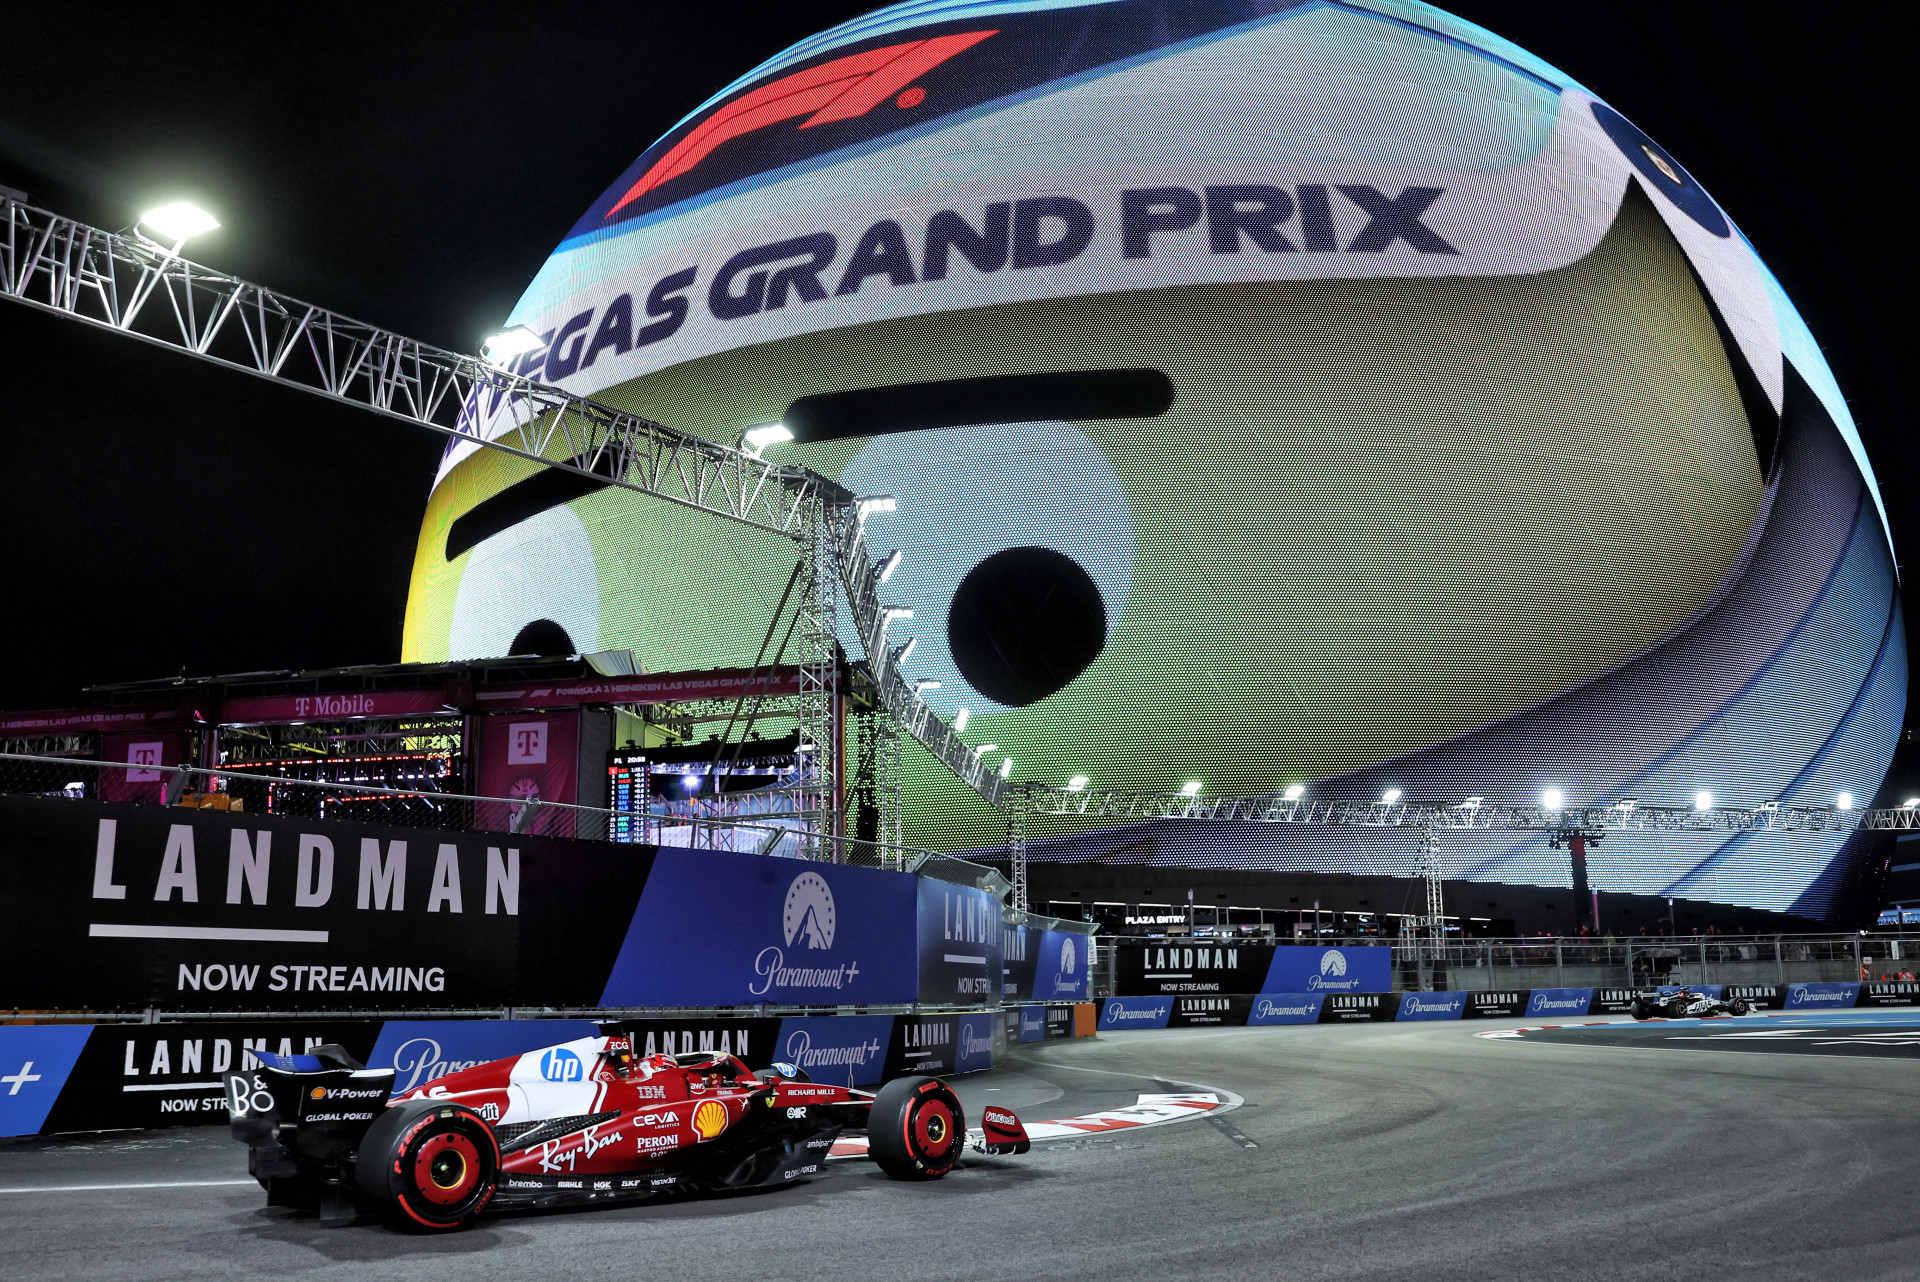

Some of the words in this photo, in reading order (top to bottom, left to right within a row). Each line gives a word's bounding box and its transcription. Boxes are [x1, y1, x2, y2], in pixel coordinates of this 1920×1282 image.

[706, 196, 1096, 321] GRAND
[1120, 184, 1461, 261] PRIX
[556, 687, 603, 696] FORMULA
[612, 683, 661, 693] HEINEKEN
[663, 680, 683, 690] LAS
[684, 678, 720, 689] VEGAS
[314, 694, 374, 716] Mobile
[50, 718, 67, 726] LAS
[93, 712, 125, 722] GRAND
[125, 712, 146, 721] PRIX
[92, 818, 521, 916] LANDMAN
[1125, 916, 1155, 924] PLAZA
[1157, 915, 1186, 924] ENTRY
[1144, 948, 1238, 969] LANDMAN
[177, 963, 260, 992] NOW
[268, 964, 445, 993] STREAMING
[748, 946, 860, 995] Paramount+
[1160, 983, 1178, 991] NOW
[1179, 983, 1219, 991] STREAMING
[1307, 974, 1360, 991] Paramount+
[1869, 984, 1920, 994] LANDMAN
[1475, 993, 1518, 1004] LANDMAN
[1729, 986, 1777, 997] LANDMAN
[1792, 987, 1853, 1004] Paramount+
[1181, 998, 1230, 1011] LANDMAN
[1256, 999, 1316, 1019] Paramount+
[1332, 996, 1380, 1008] LANDMAN
[1404, 996, 1461, 1016] Paramount+
[1533, 994, 1586, 1012] Paramount+
[1107, 1002, 1166, 1023] Paramount+
[904, 1022, 950, 1048] LANDMAN
[629, 1029, 749, 1059] LANDMAN
[786, 1030, 880, 1067] Paramount+
[546, 1048, 579, 1083] hp
[326, 1088, 383, 1099] V-Power
[636, 1085, 666, 1099] IBM
[161, 1098, 200, 1112] NOW
[306, 1113, 341, 1122] GLOBAL
[343, 1112, 373, 1120] POKER
[398, 1114, 435, 1158] ZERO
[637, 1134, 679, 1149] PERONI
[508, 1179, 543, 1188] brembo
[593, 1181, 612, 1189] NGK
